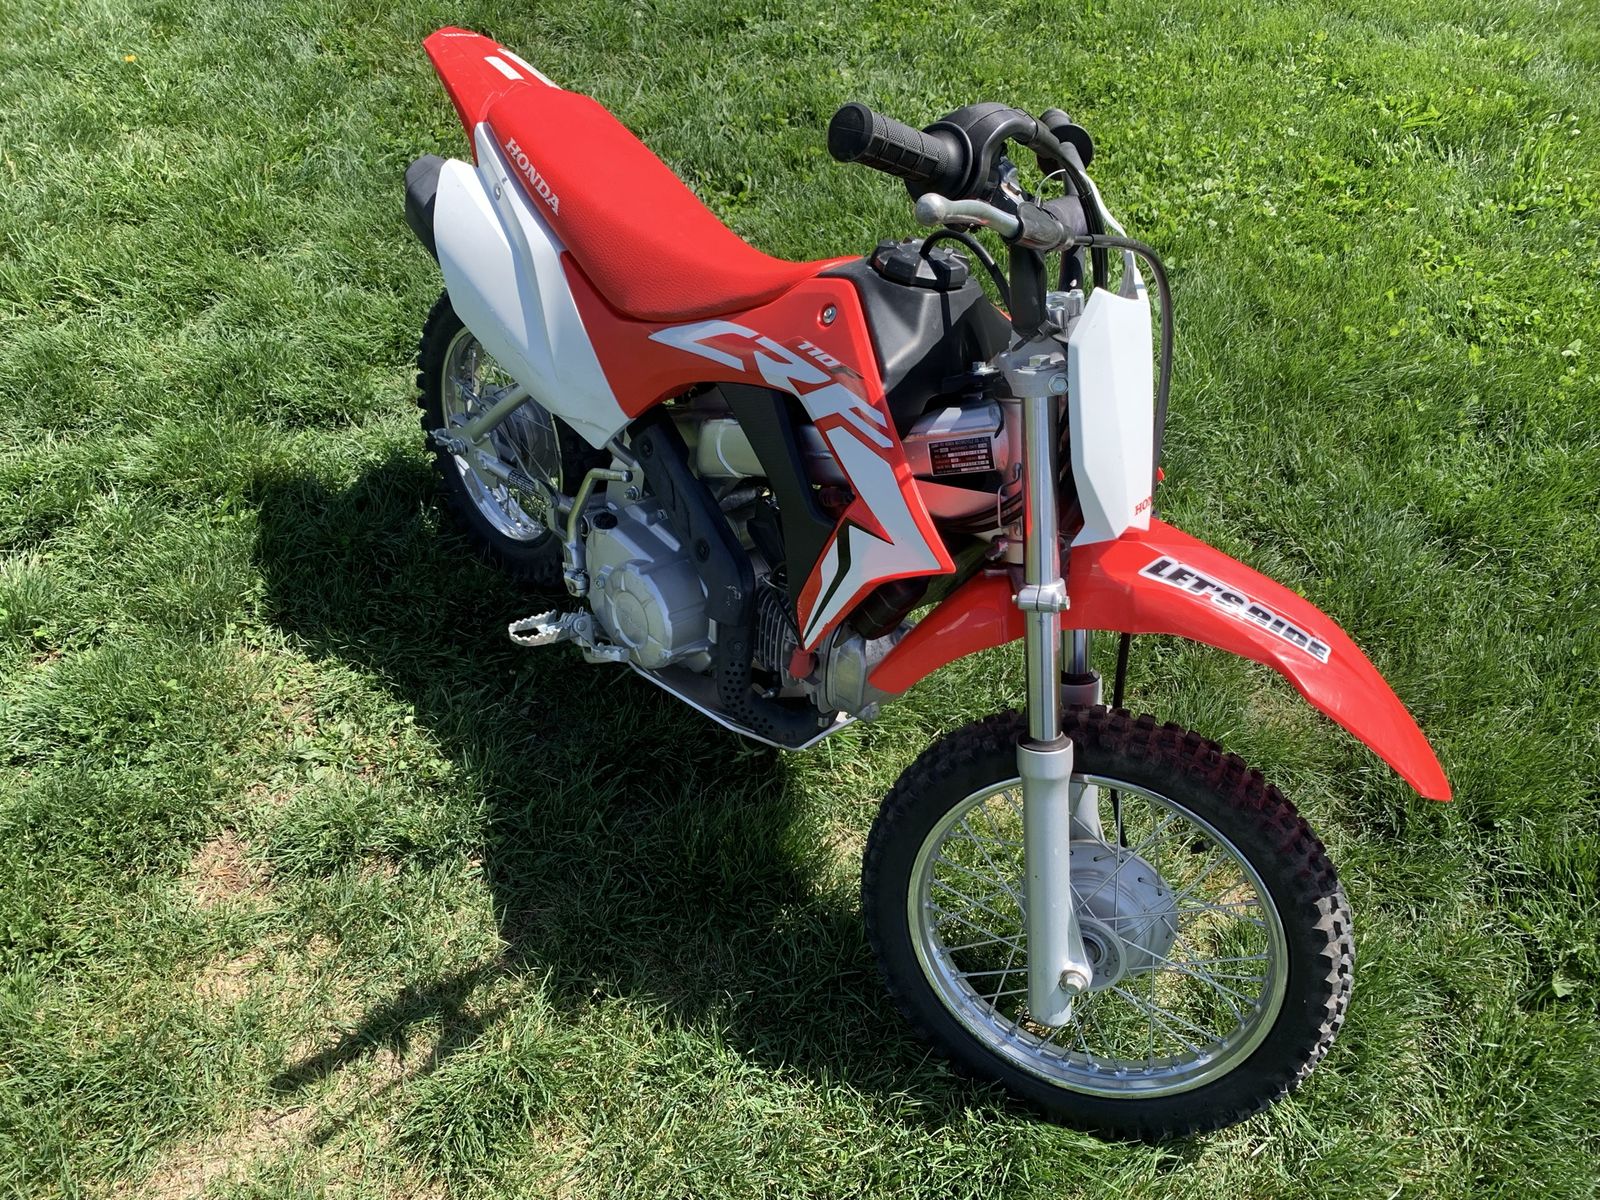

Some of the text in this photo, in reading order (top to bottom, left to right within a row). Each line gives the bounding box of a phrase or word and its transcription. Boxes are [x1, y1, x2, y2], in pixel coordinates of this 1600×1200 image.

[505, 137, 559, 216] HONDA
[648, 320, 894, 448] CRF
[797, 341, 841, 367] 110
[1145, 559, 1329, 661] LET'S RIDE
